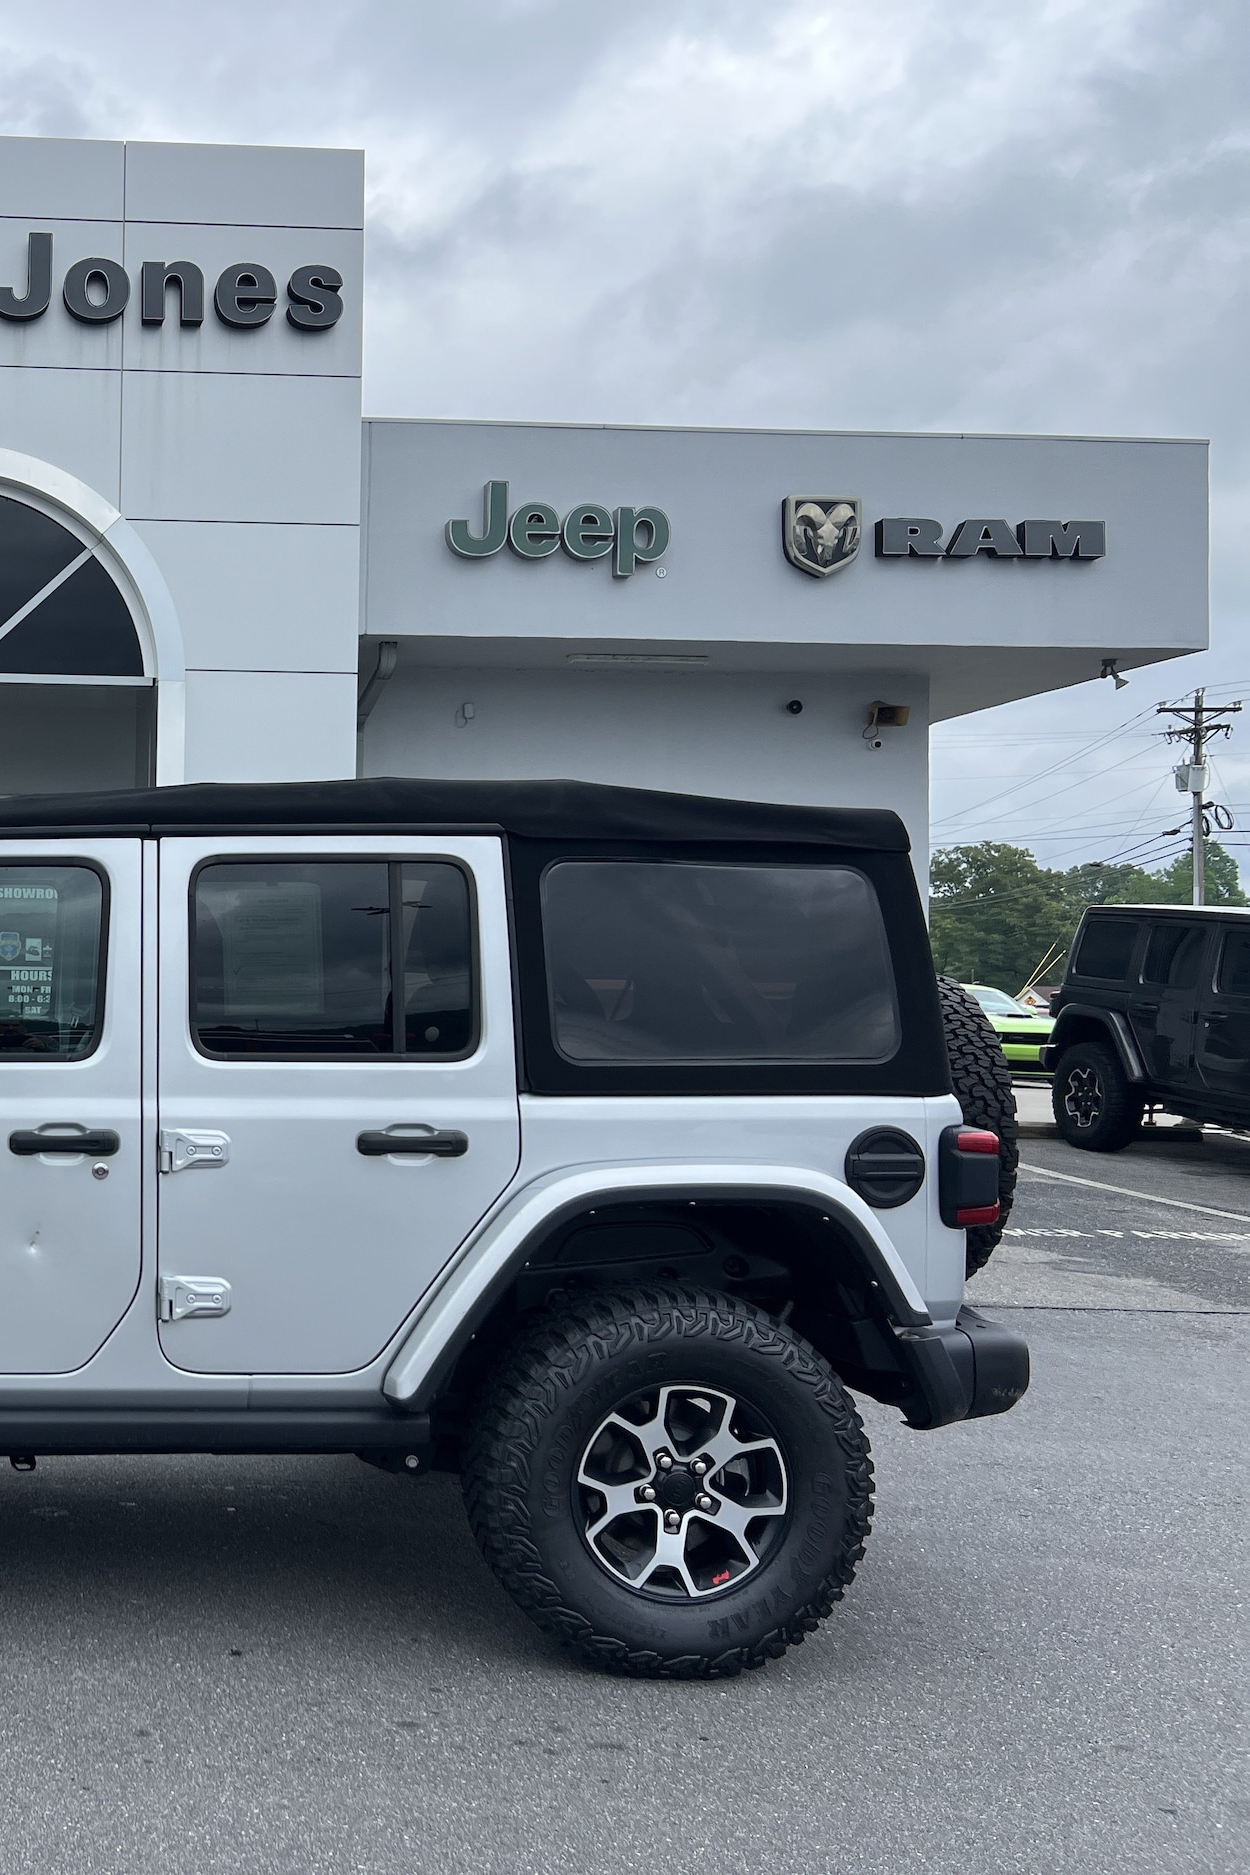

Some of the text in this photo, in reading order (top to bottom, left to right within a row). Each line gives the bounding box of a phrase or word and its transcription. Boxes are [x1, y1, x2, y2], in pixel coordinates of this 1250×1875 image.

[444, 480, 672, 579] Jeep
[875, 516, 1107, 561] RAM
[8, 994, 30, 1003] 8:00
